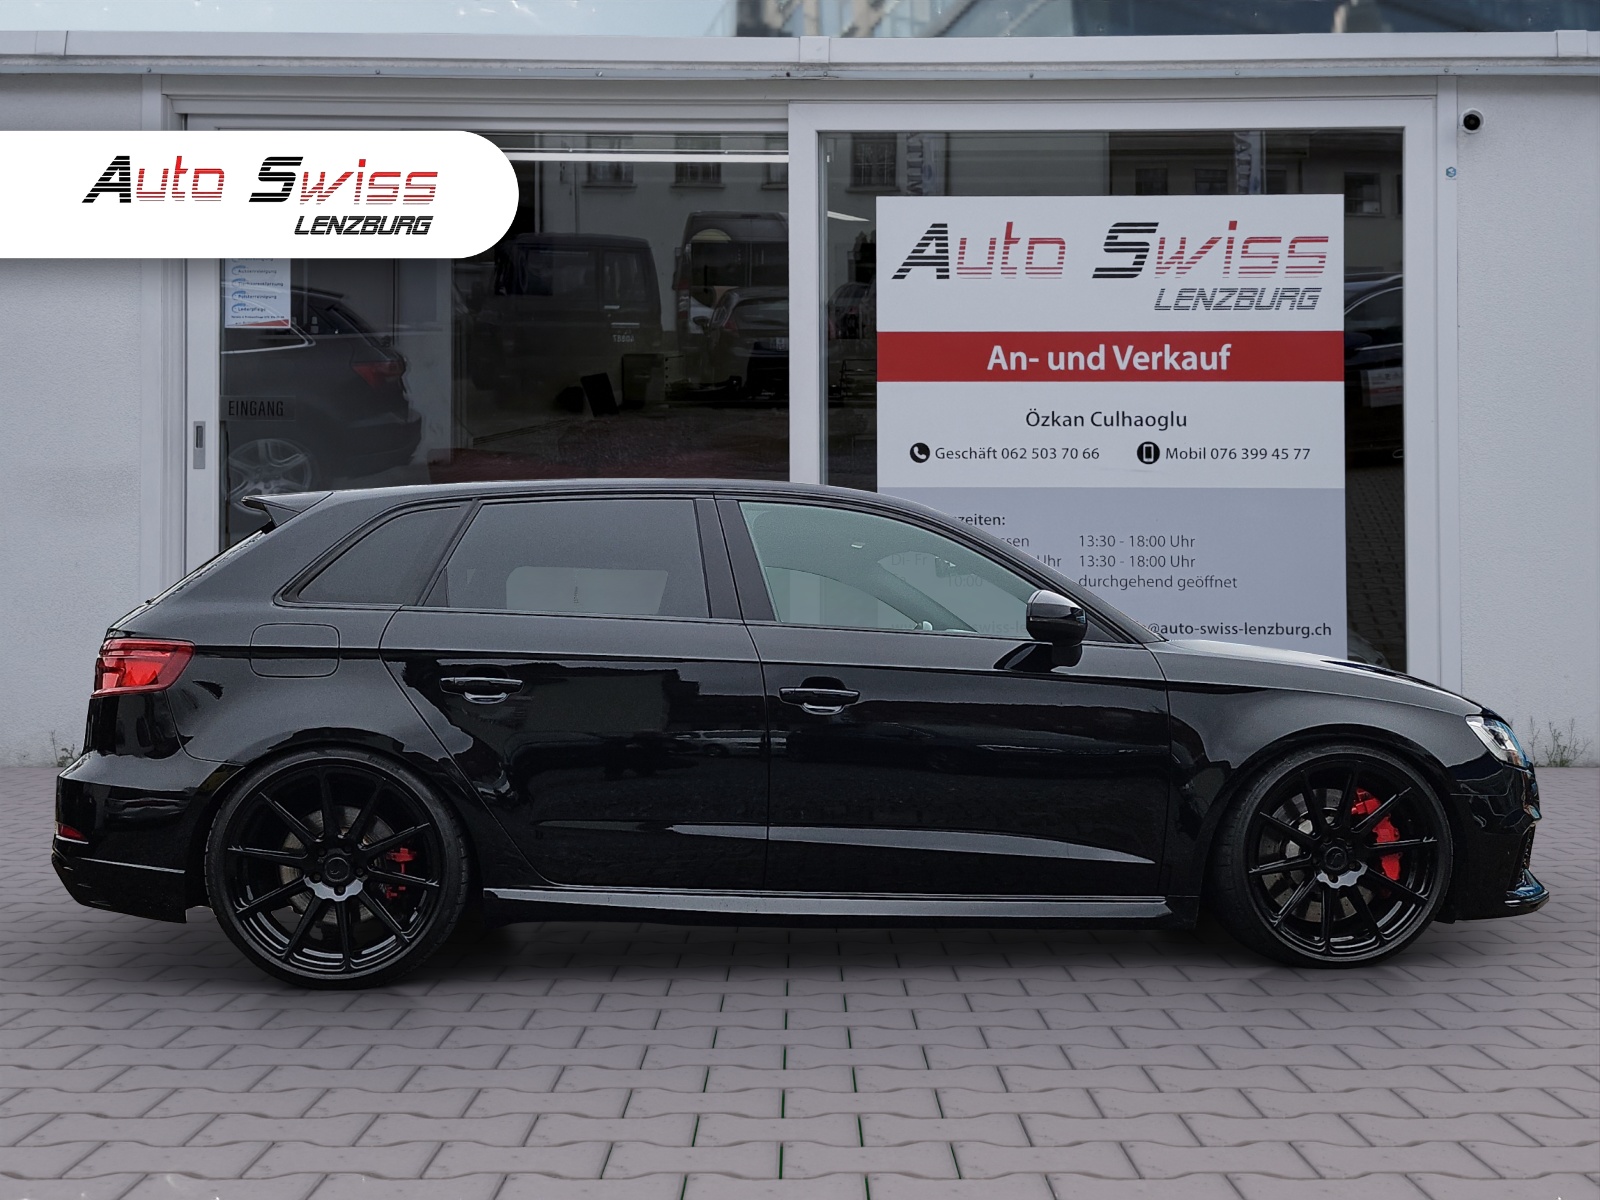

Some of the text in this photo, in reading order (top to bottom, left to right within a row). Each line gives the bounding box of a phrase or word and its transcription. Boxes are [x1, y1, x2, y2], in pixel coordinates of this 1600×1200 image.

[892, 220, 1329, 279] Auto Swiss
[1154, 288, 1322, 310] LENZBURG
[987, 343, 1232, 370] An- und Verkauf
[228, 401, 284, 417] EINGANG
[1026, 408, 1187, 431] Özkan Culhaoglu
[935, 447, 1100, 460] Geschäft 062 503 70 66
[1165, 447, 1311, 460] Mobil 076 399 45 77
[1079, 535, 1116, 547] 13:30
[1129, 535, 1166, 547] 18:00
[1170, 535, 1196, 547] Uhr
[1080, 555, 1116, 568] 13:30
[1129, 555, 1166, 567] 18:00
[1170, 555, 1196, 568] Uhr
[1078, 575, 1173, 590] durchgehend
[1177, 575, 1238, 591] geöffnet
[1147, 622, 1332, 638] @auto-swiss-lenzburg.ch
